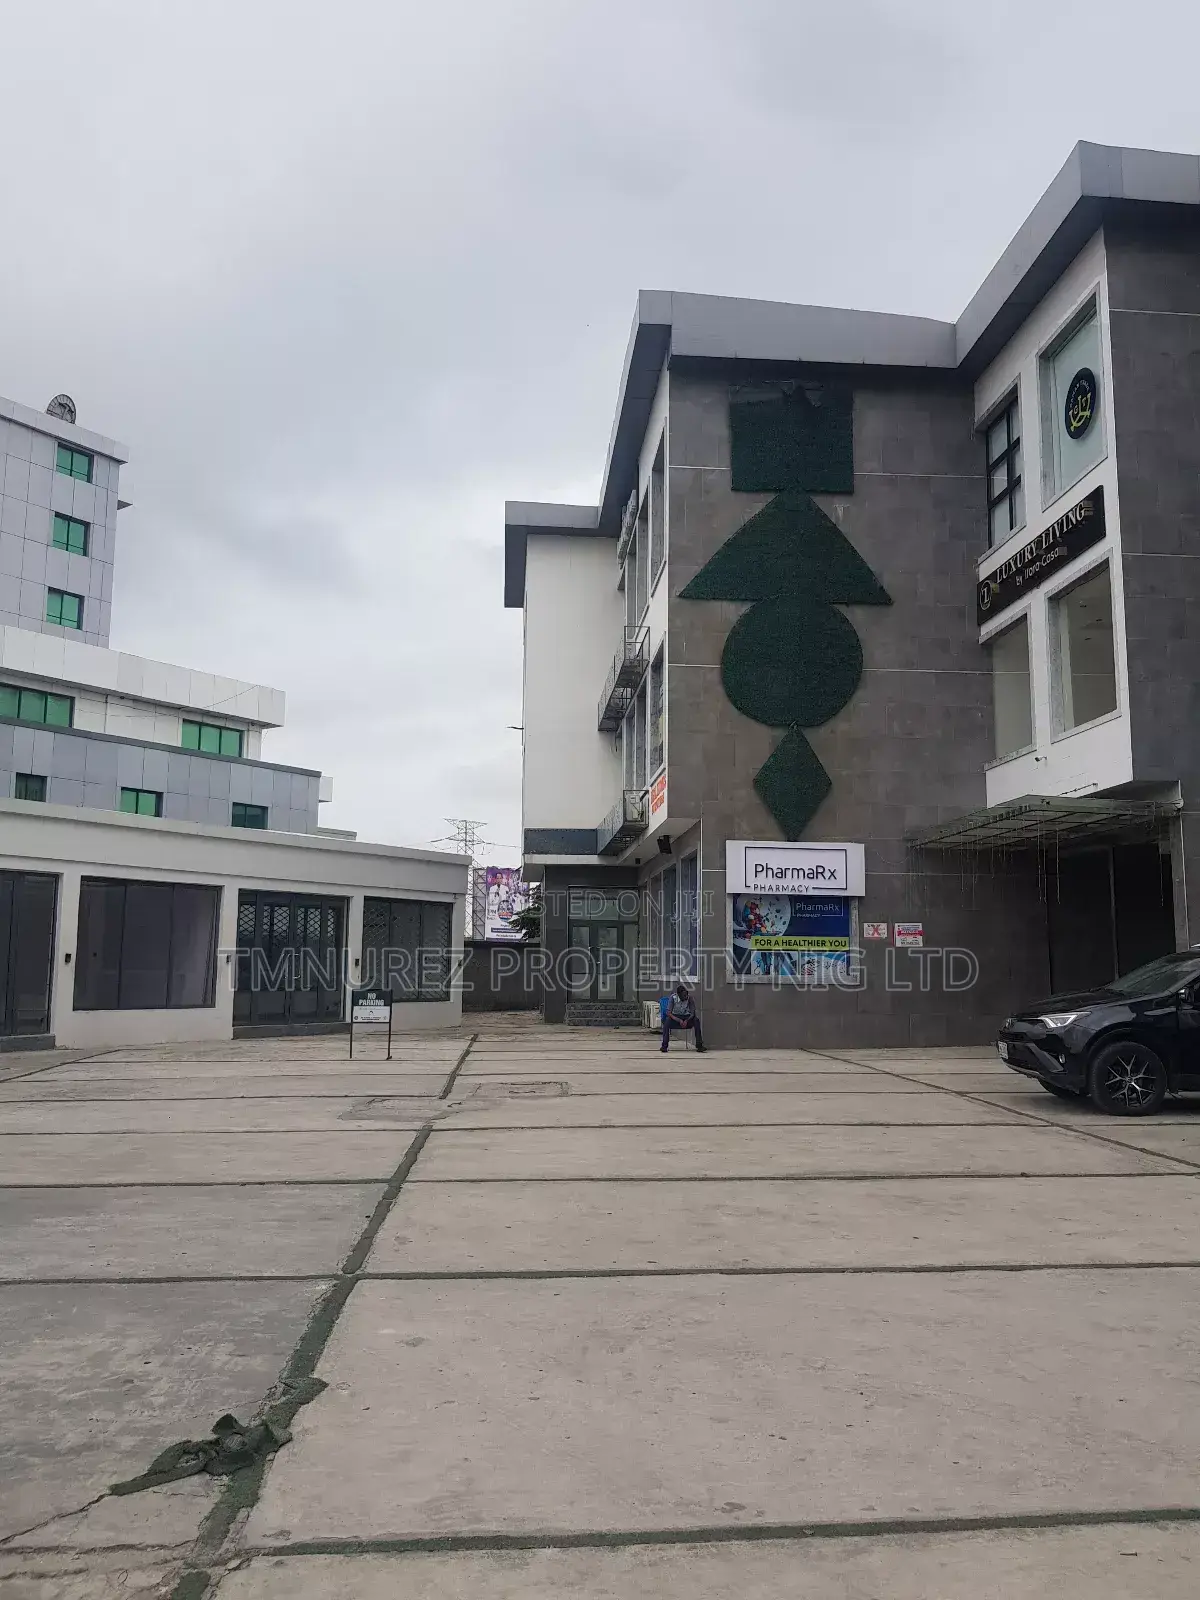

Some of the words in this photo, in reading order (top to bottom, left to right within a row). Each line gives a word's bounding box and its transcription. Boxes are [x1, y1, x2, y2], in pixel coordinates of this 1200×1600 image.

[996, 540, 1037, 584] LUXURY
[1041, 502, 1085, 549] LIVING
[1015, 575, 1023, 586] by
[1041, 547, 1059, 567] Casa
[754, 863, 837, 880] PharmaRx
[753, 884, 810, 893] PHARMACY
[796, 903, 840, 911] PharmaRx
[754, 939, 772, 947] FOR
[774, 939, 780, 947] A
[781, 939, 826, 947] HEALTHIER
[828, 940, 847, 948] YOU
